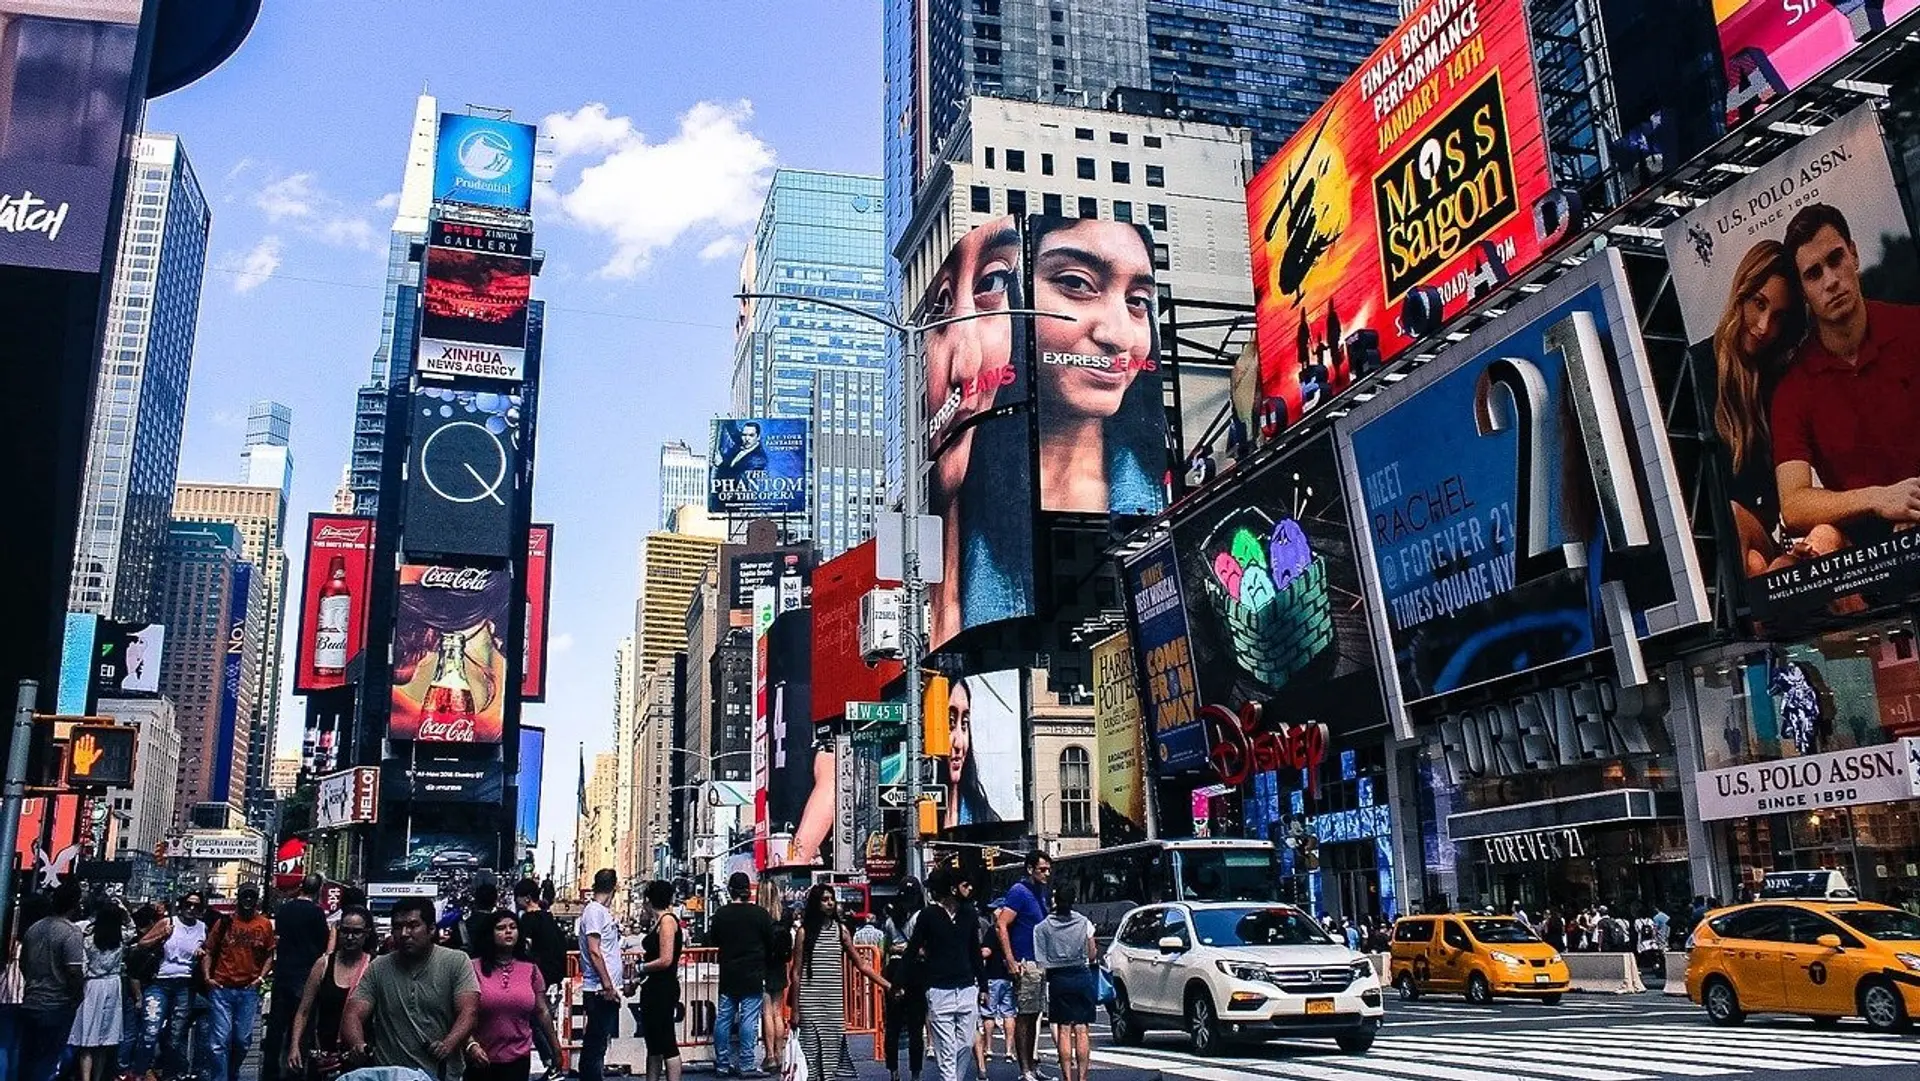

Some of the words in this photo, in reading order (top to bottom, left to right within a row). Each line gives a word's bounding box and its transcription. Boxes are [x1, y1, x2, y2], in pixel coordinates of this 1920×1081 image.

[1360, 48, 1398, 102] FINAL
[1374, 2, 1480, 122] PERFORMANCE
[1378, 73, 1441, 154] JANUARY
[1446, 33, 1485, 89] 14TH
[456, 177, 511, 194] Prudential
[1716, 208, 1747, 234] U.S.
[1748, 177, 1795, 216] POLO
[1800, 144, 1853, 187] ASSN.
[485, 229, 518, 240] XINHUA
[1748, 209, 1783, 235] SINCE
[444, 235, 517, 252] GALLERY
[427, 359, 462, 371] NEWS
[465, 362, 516, 377] AGENCY
[442, 347, 502, 365] XINHUA
[1043, 351, 1111, 369] EXPRESS
[710, 477, 803, 494] PHANTOM
[745, 470, 768, 479] THE
[1366, 461, 1403, 511] MEET
[718, 492, 734, 501] OF
[736, 491, 759, 500] THE
[759, 490, 795, 500] OPERA
[1375, 474, 1475, 546] RACHEL
[1400, 516, 1485, 583] FOREVER
[420, 565, 491, 591] Coca-Cola
[1767, 569, 1802, 590] LIVE
[1391, 584, 1433, 631] TIMES
[1433, 563, 1492, 619] SQUARE
[1146, 634, 1190, 678] COME
[860, 704, 871, 719] W
[876, 705, 890, 719] 45
[1156, 691, 1196, 733] AWAY
[1435, 675, 1652, 785] FOREVER
[1716, 771, 1755, 797] U.S.
[1758, 762, 1822, 792] POLO
[1829, 750, 1904, 783] ASSN.
[887, 791, 907, 801] ONE
[1758, 793, 1807, 810] SINCE
[1814, 788, 1858, 803] 1890
[1484, 831, 1562, 865] FOREVER
[1562, 828, 1585, 858] 21
